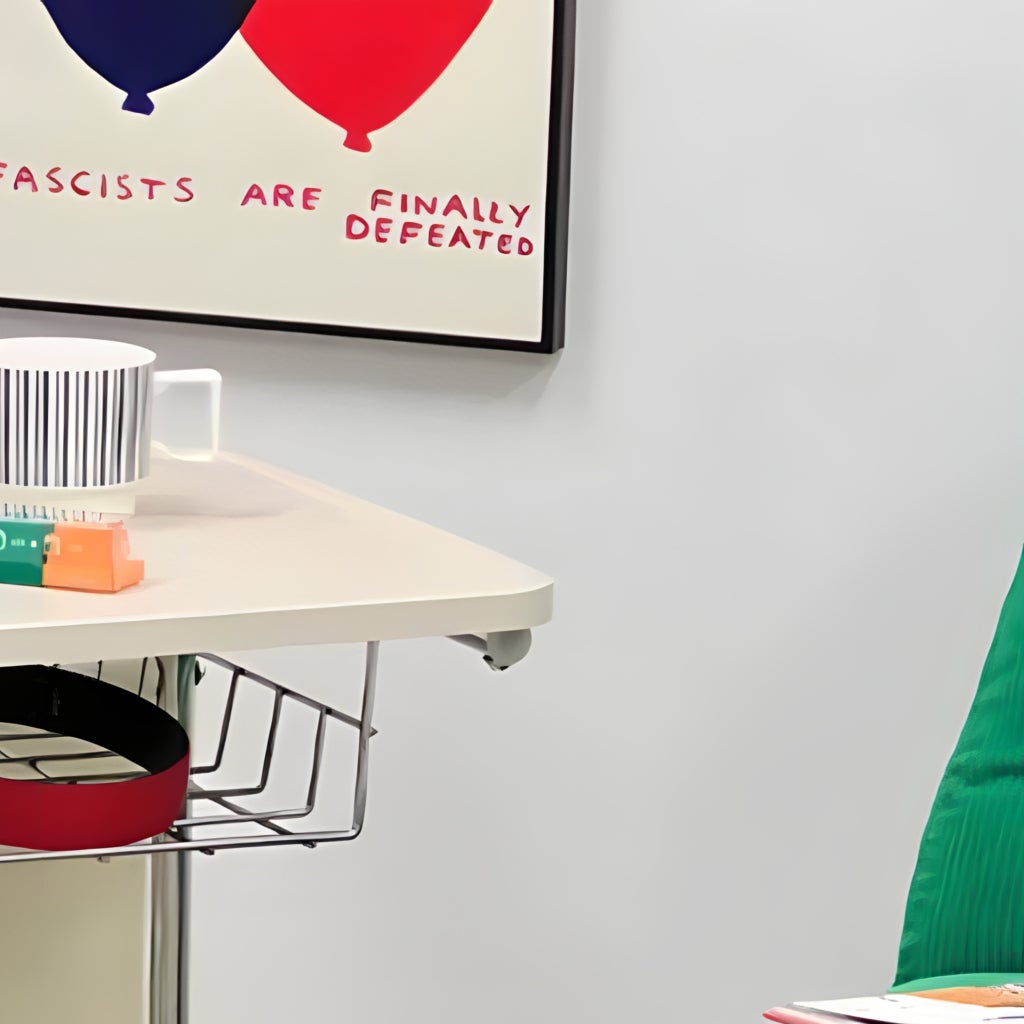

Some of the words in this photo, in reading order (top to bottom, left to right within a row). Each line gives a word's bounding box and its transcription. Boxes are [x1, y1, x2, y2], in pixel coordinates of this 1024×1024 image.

[240, 183, 323, 211] ARE
[370, 188, 531, 229] FINALLY
[345, 213, 534, 256] DEFEATED
